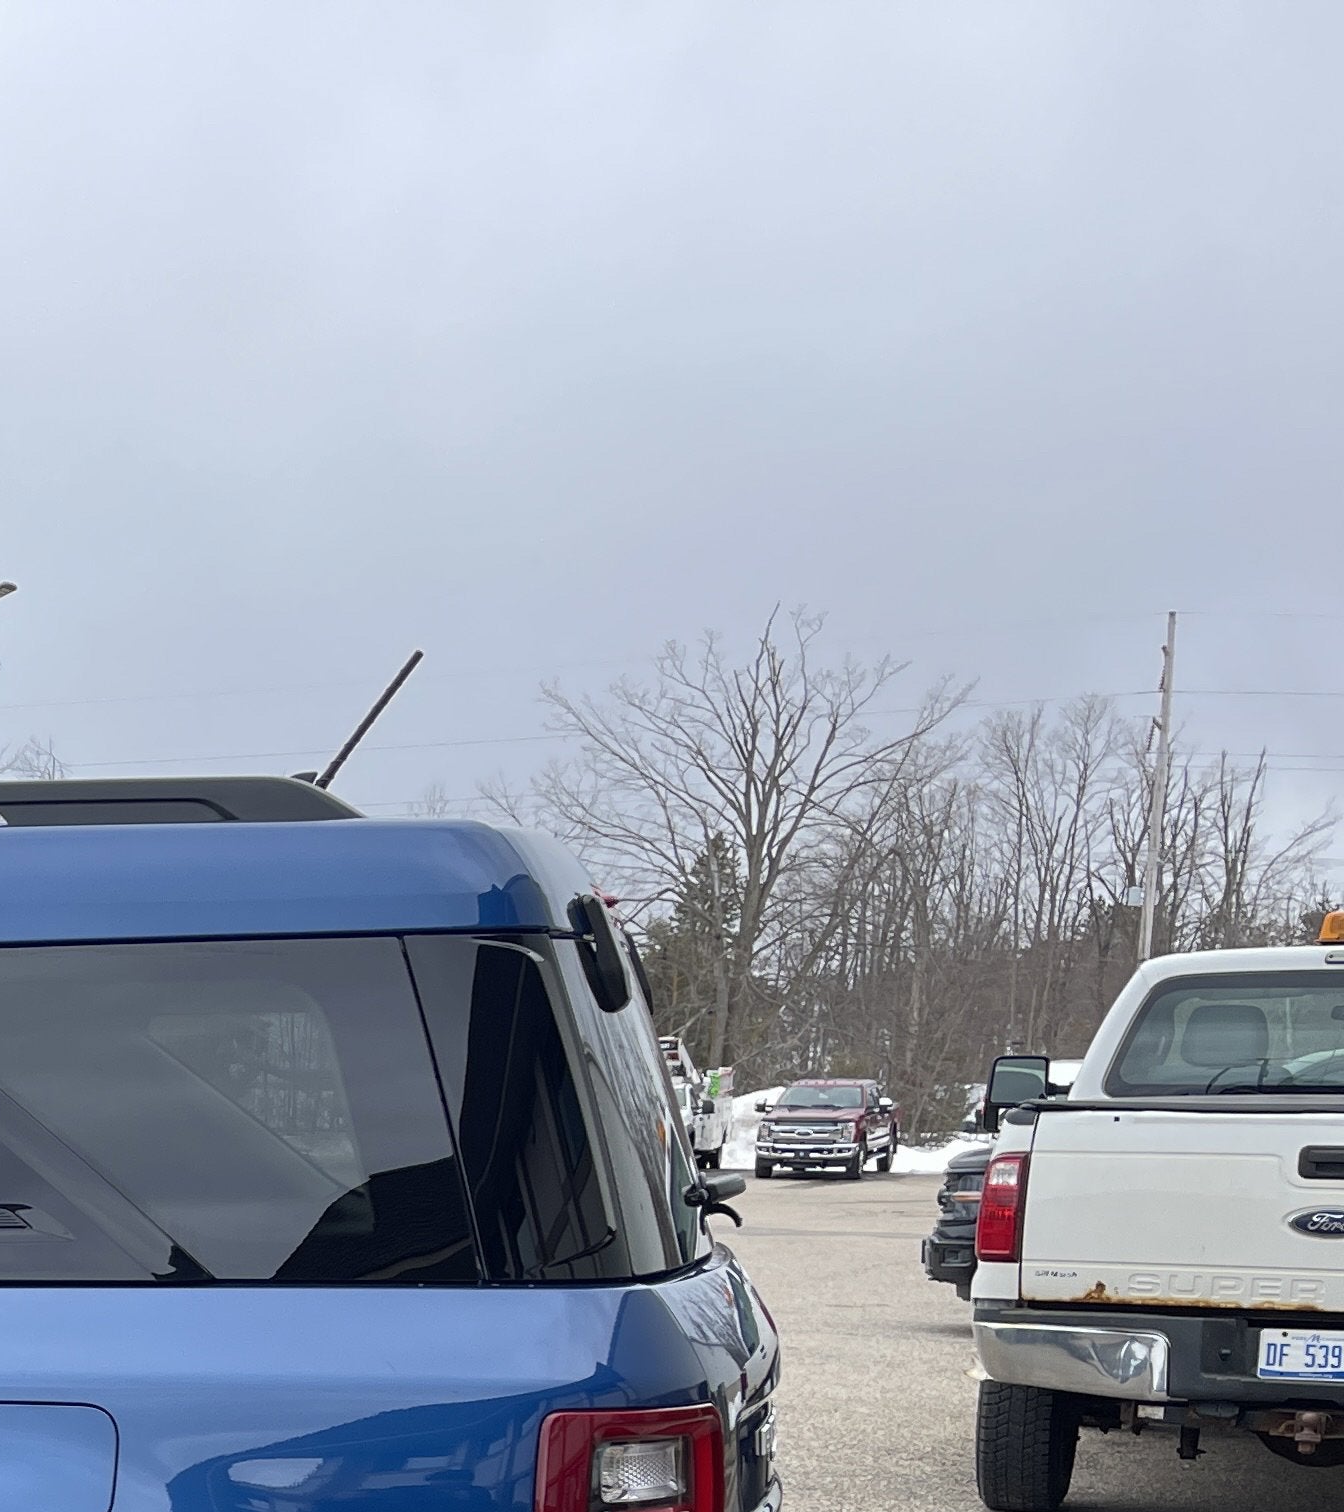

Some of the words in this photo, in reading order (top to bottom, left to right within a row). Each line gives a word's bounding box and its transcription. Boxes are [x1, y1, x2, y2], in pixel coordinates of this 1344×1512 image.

[1127, 1273, 1326, 1303] SUPER
[1265, 1343, 1291, 1366] DF
[1304, 1344, 1342, 1369] 539
